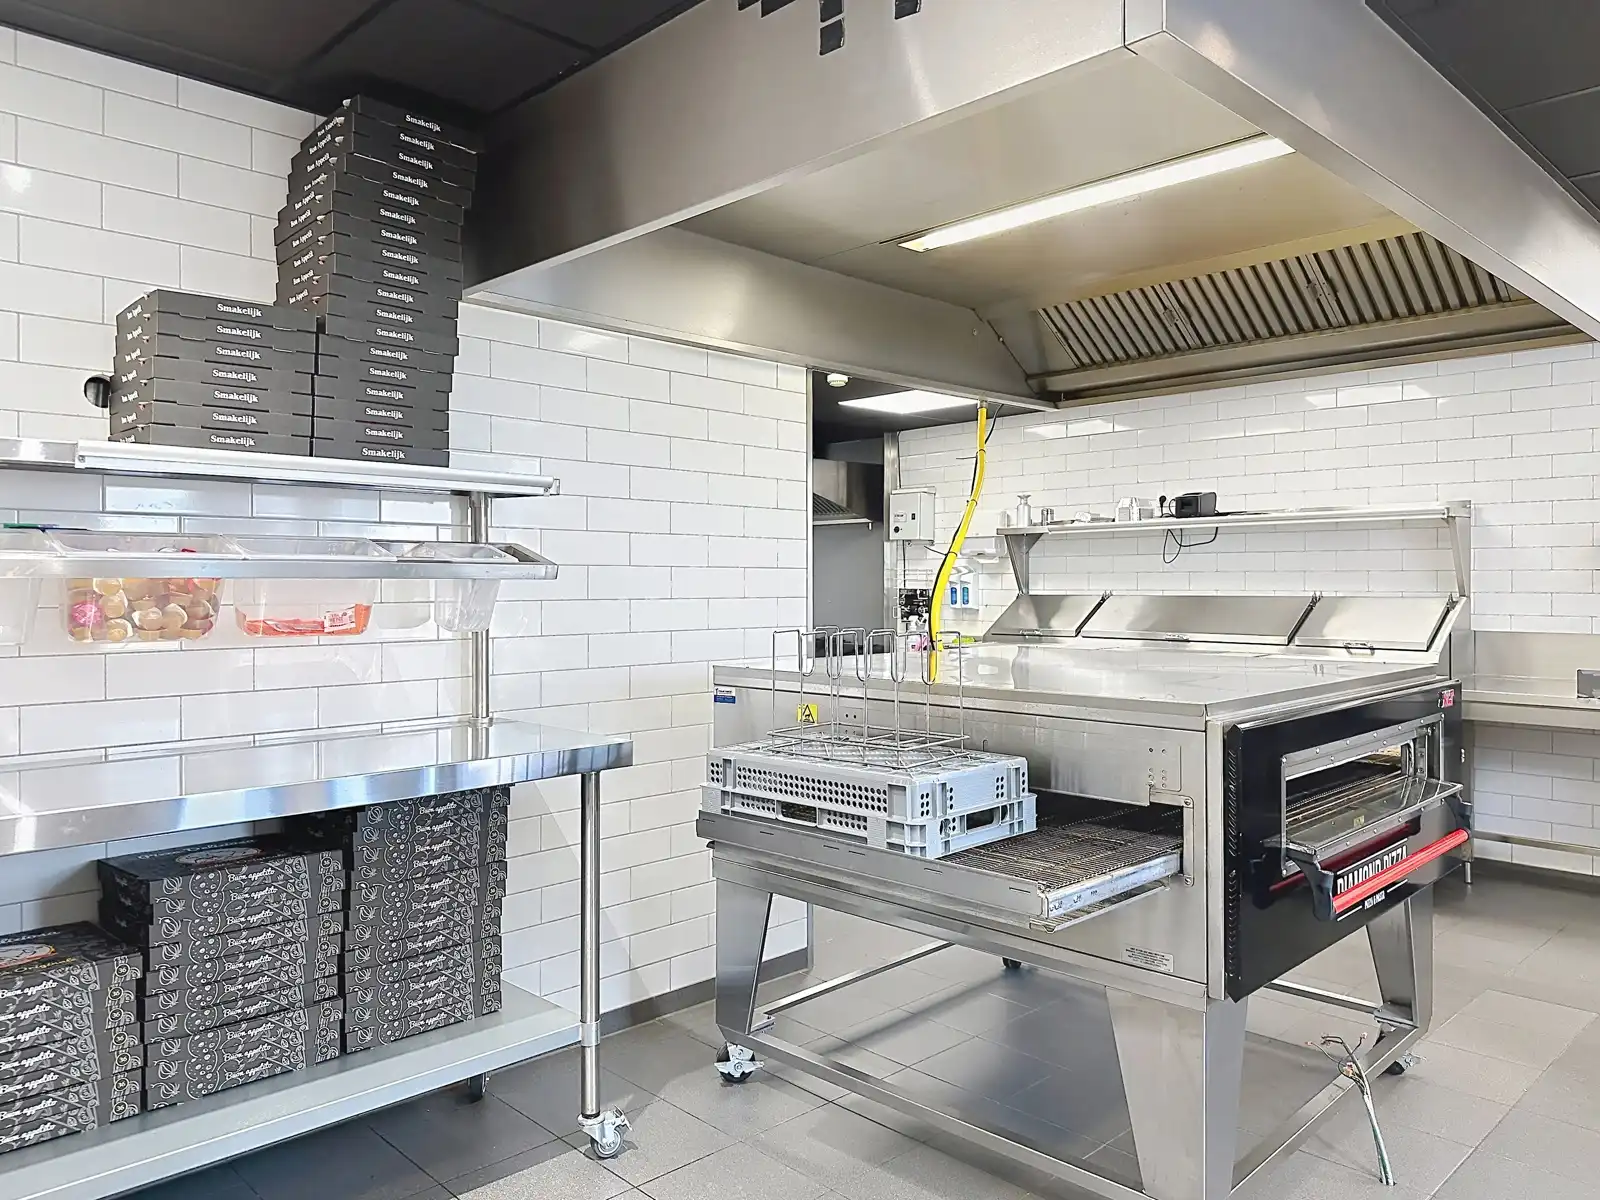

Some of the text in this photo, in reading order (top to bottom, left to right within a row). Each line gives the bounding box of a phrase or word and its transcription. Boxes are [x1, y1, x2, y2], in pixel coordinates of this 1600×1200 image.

[406, 114, 441, 132] Smakelijk
[400, 133, 435, 150] Smakelijk
[399, 152, 433, 170] Smakelijk
[392, 172, 428, 188] Smakelijk
[383, 190, 419, 206] Smakelijk
[380, 208, 416, 224] Smakelijk
[381, 229, 417, 245] Smakelijk
[382, 250, 418, 264] Smakelijk
[382, 270, 419, 284] Smakelijk
[377, 289, 414, 303] Smakelijk
[217, 304, 262, 317] Smakelijk
[376, 310, 413, 323] Smakelijk
[217, 326, 262, 339] Smakelijk
[376, 328, 414, 342] Smakelijk
[216, 347, 261, 360] Smakelijk
[370, 348, 408, 360] Smakelijk
[213, 370, 257, 382] Smakelijk
[370, 368, 407, 380] Smakelijk
[214, 391, 258, 403] Smakelijk
[366, 388, 404, 400] Smakelijk
[213, 413, 257, 425] Smakelijk
[366, 408, 403, 420] Smakelijk
[210, 435, 255, 447] Smakelijk
[366, 428, 403, 439] Smakelijk
[362, 448, 405, 459] Smakelijk
[228, 867, 275, 882] Buon appetito
[231, 886, 278, 901] Buon appetito
[226, 909, 274, 924] Buon appetito
[228, 931, 275, 947] Buon appetito
[224, 954, 272, 970] Buon appetito
[24, 980, 58, 995] appetito
[224, 976, 271, 992] Buon appetito
[20, 1003, 52, 1019] appetito
[223, 1000, 271, 1017] Buon appetito
[17, 1025, 51, 1042] appetito
[227, 1022, 275, 1040] Buon appetito
[21, 1050, 56, 1067] appetito
[224, 1043, 271, 1061] Buon appetito
[225, 1062, 273, 1080] Buon appetito
[25, 1072, 59, 1089] appetito
[23, 1098, 57, 1115] appetito
[20, 1123, 56, 1140] appetito
